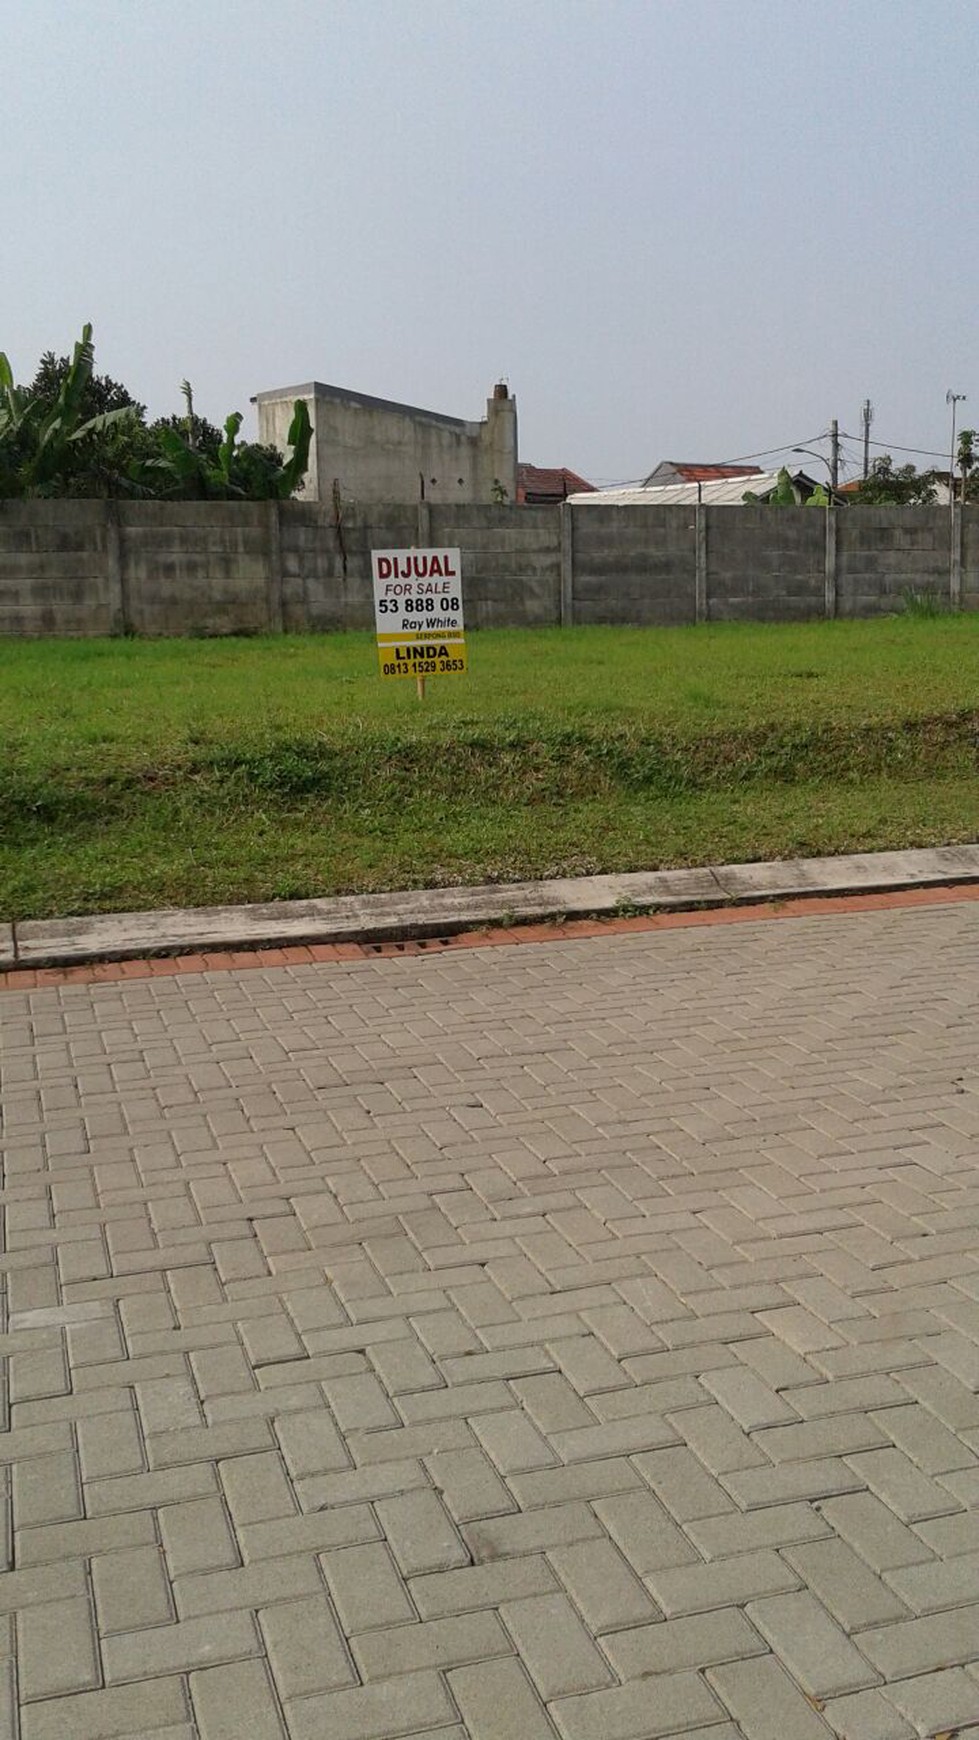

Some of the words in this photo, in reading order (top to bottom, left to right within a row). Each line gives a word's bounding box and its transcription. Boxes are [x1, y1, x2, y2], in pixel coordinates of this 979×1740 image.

[378, 555, 456, 579] DIJUAL
[385, 584, 412, 596] FOR
[417, 582, 450, 594] SALE
[379, 599, 399, 613] 53
[405, 598, 434, 612] 888
[440, 597, 459, 611] 08
[402, 619, 424, 631] Ray
[426, 618, 457, 628] White
[396, 646, 449, 660] LINDA
[383, 662, 408, 675] 0813
[412, 661, 436, 672] 1529
[440, 660, 464, 672] 3653
